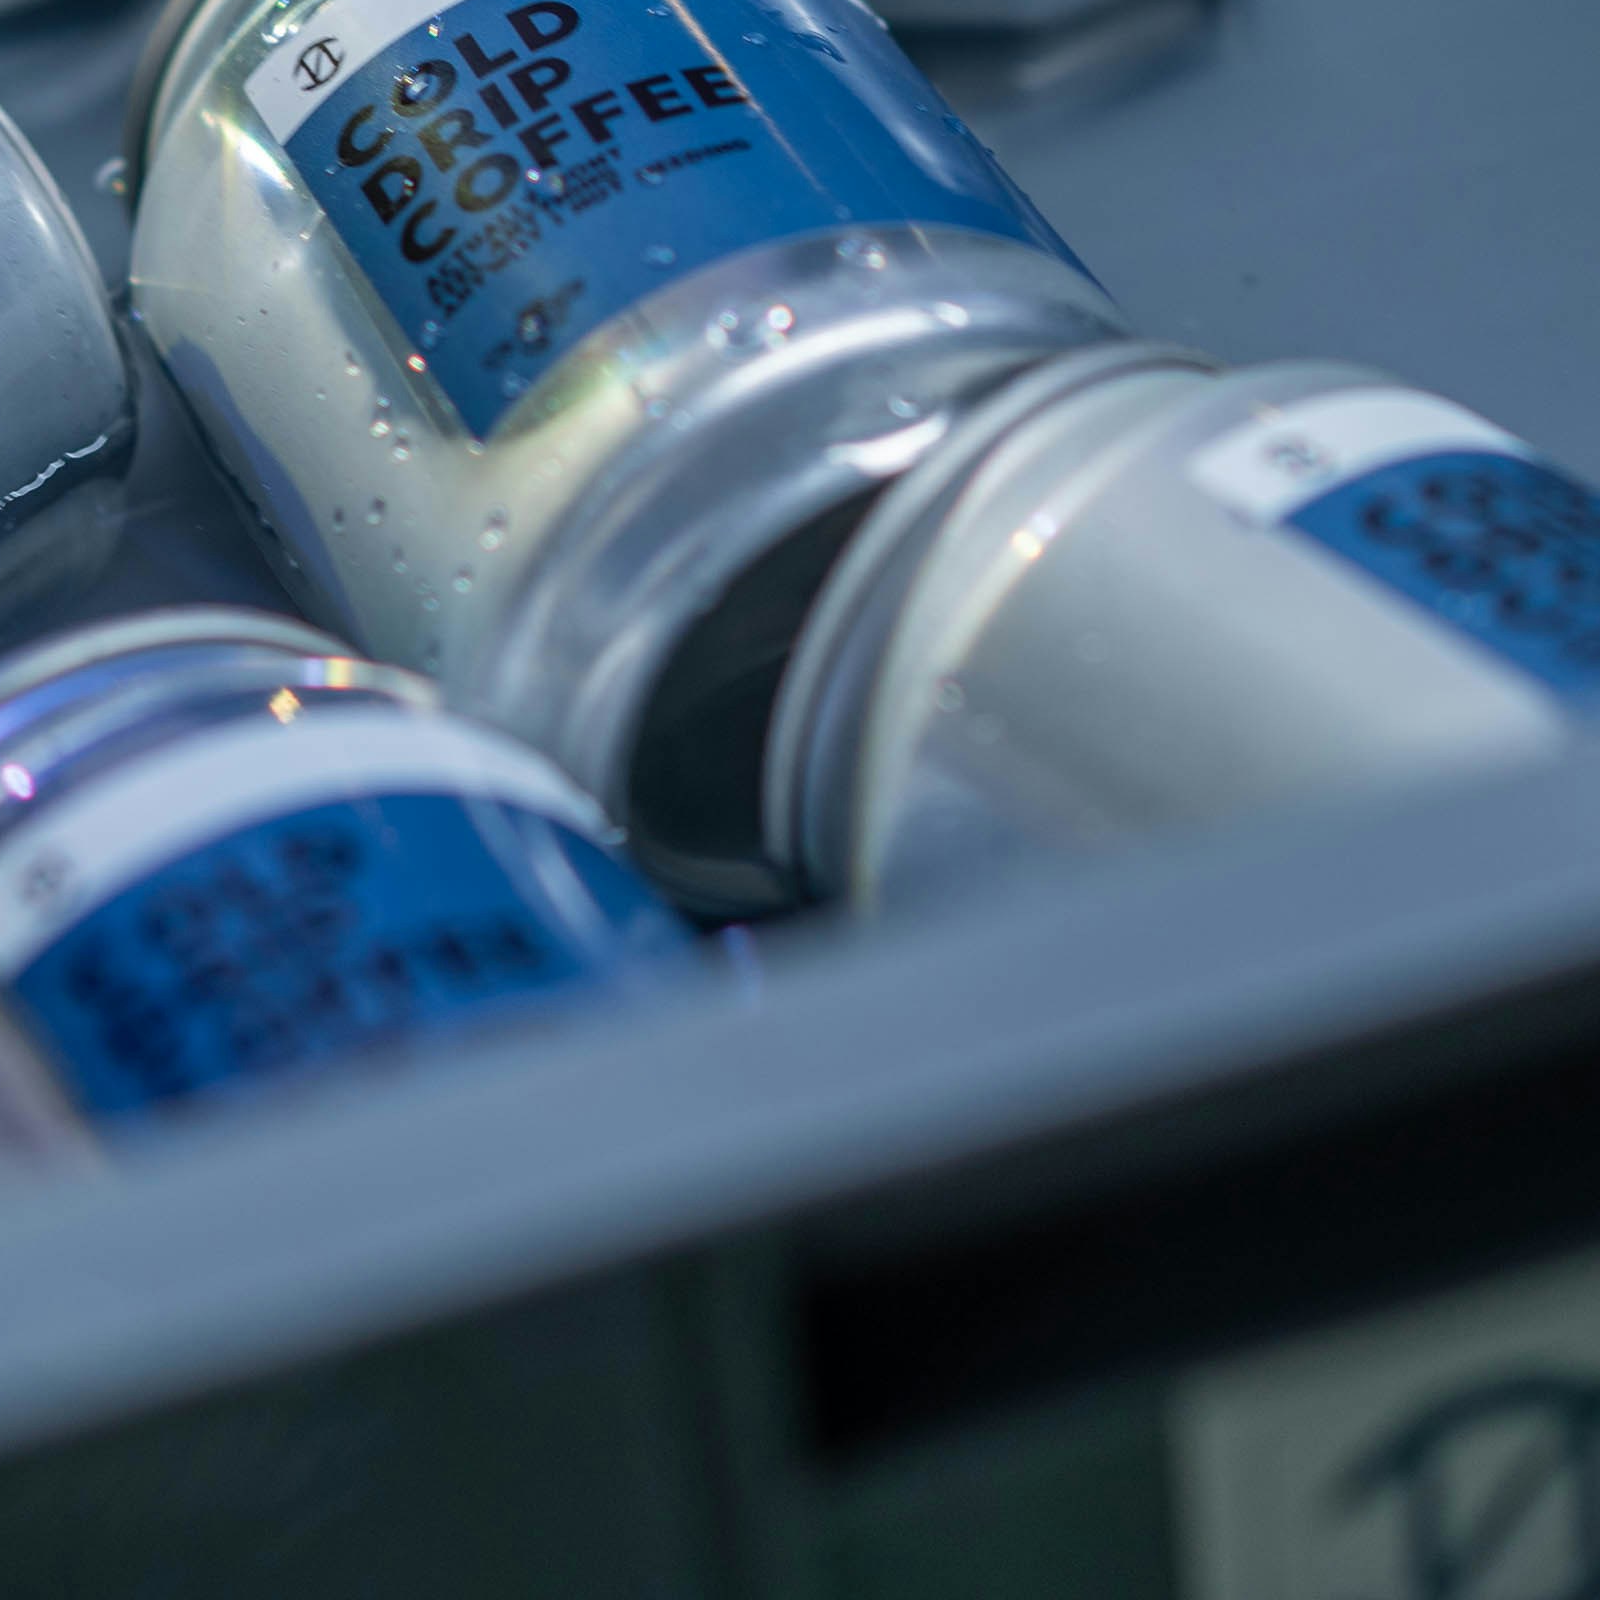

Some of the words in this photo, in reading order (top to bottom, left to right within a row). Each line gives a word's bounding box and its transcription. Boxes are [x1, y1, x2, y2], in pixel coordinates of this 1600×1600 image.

[336, 0, 579, 168] COLD
[360, 58, 572, 225] DRIP
[401, 64, 749, 264] COFFEE
